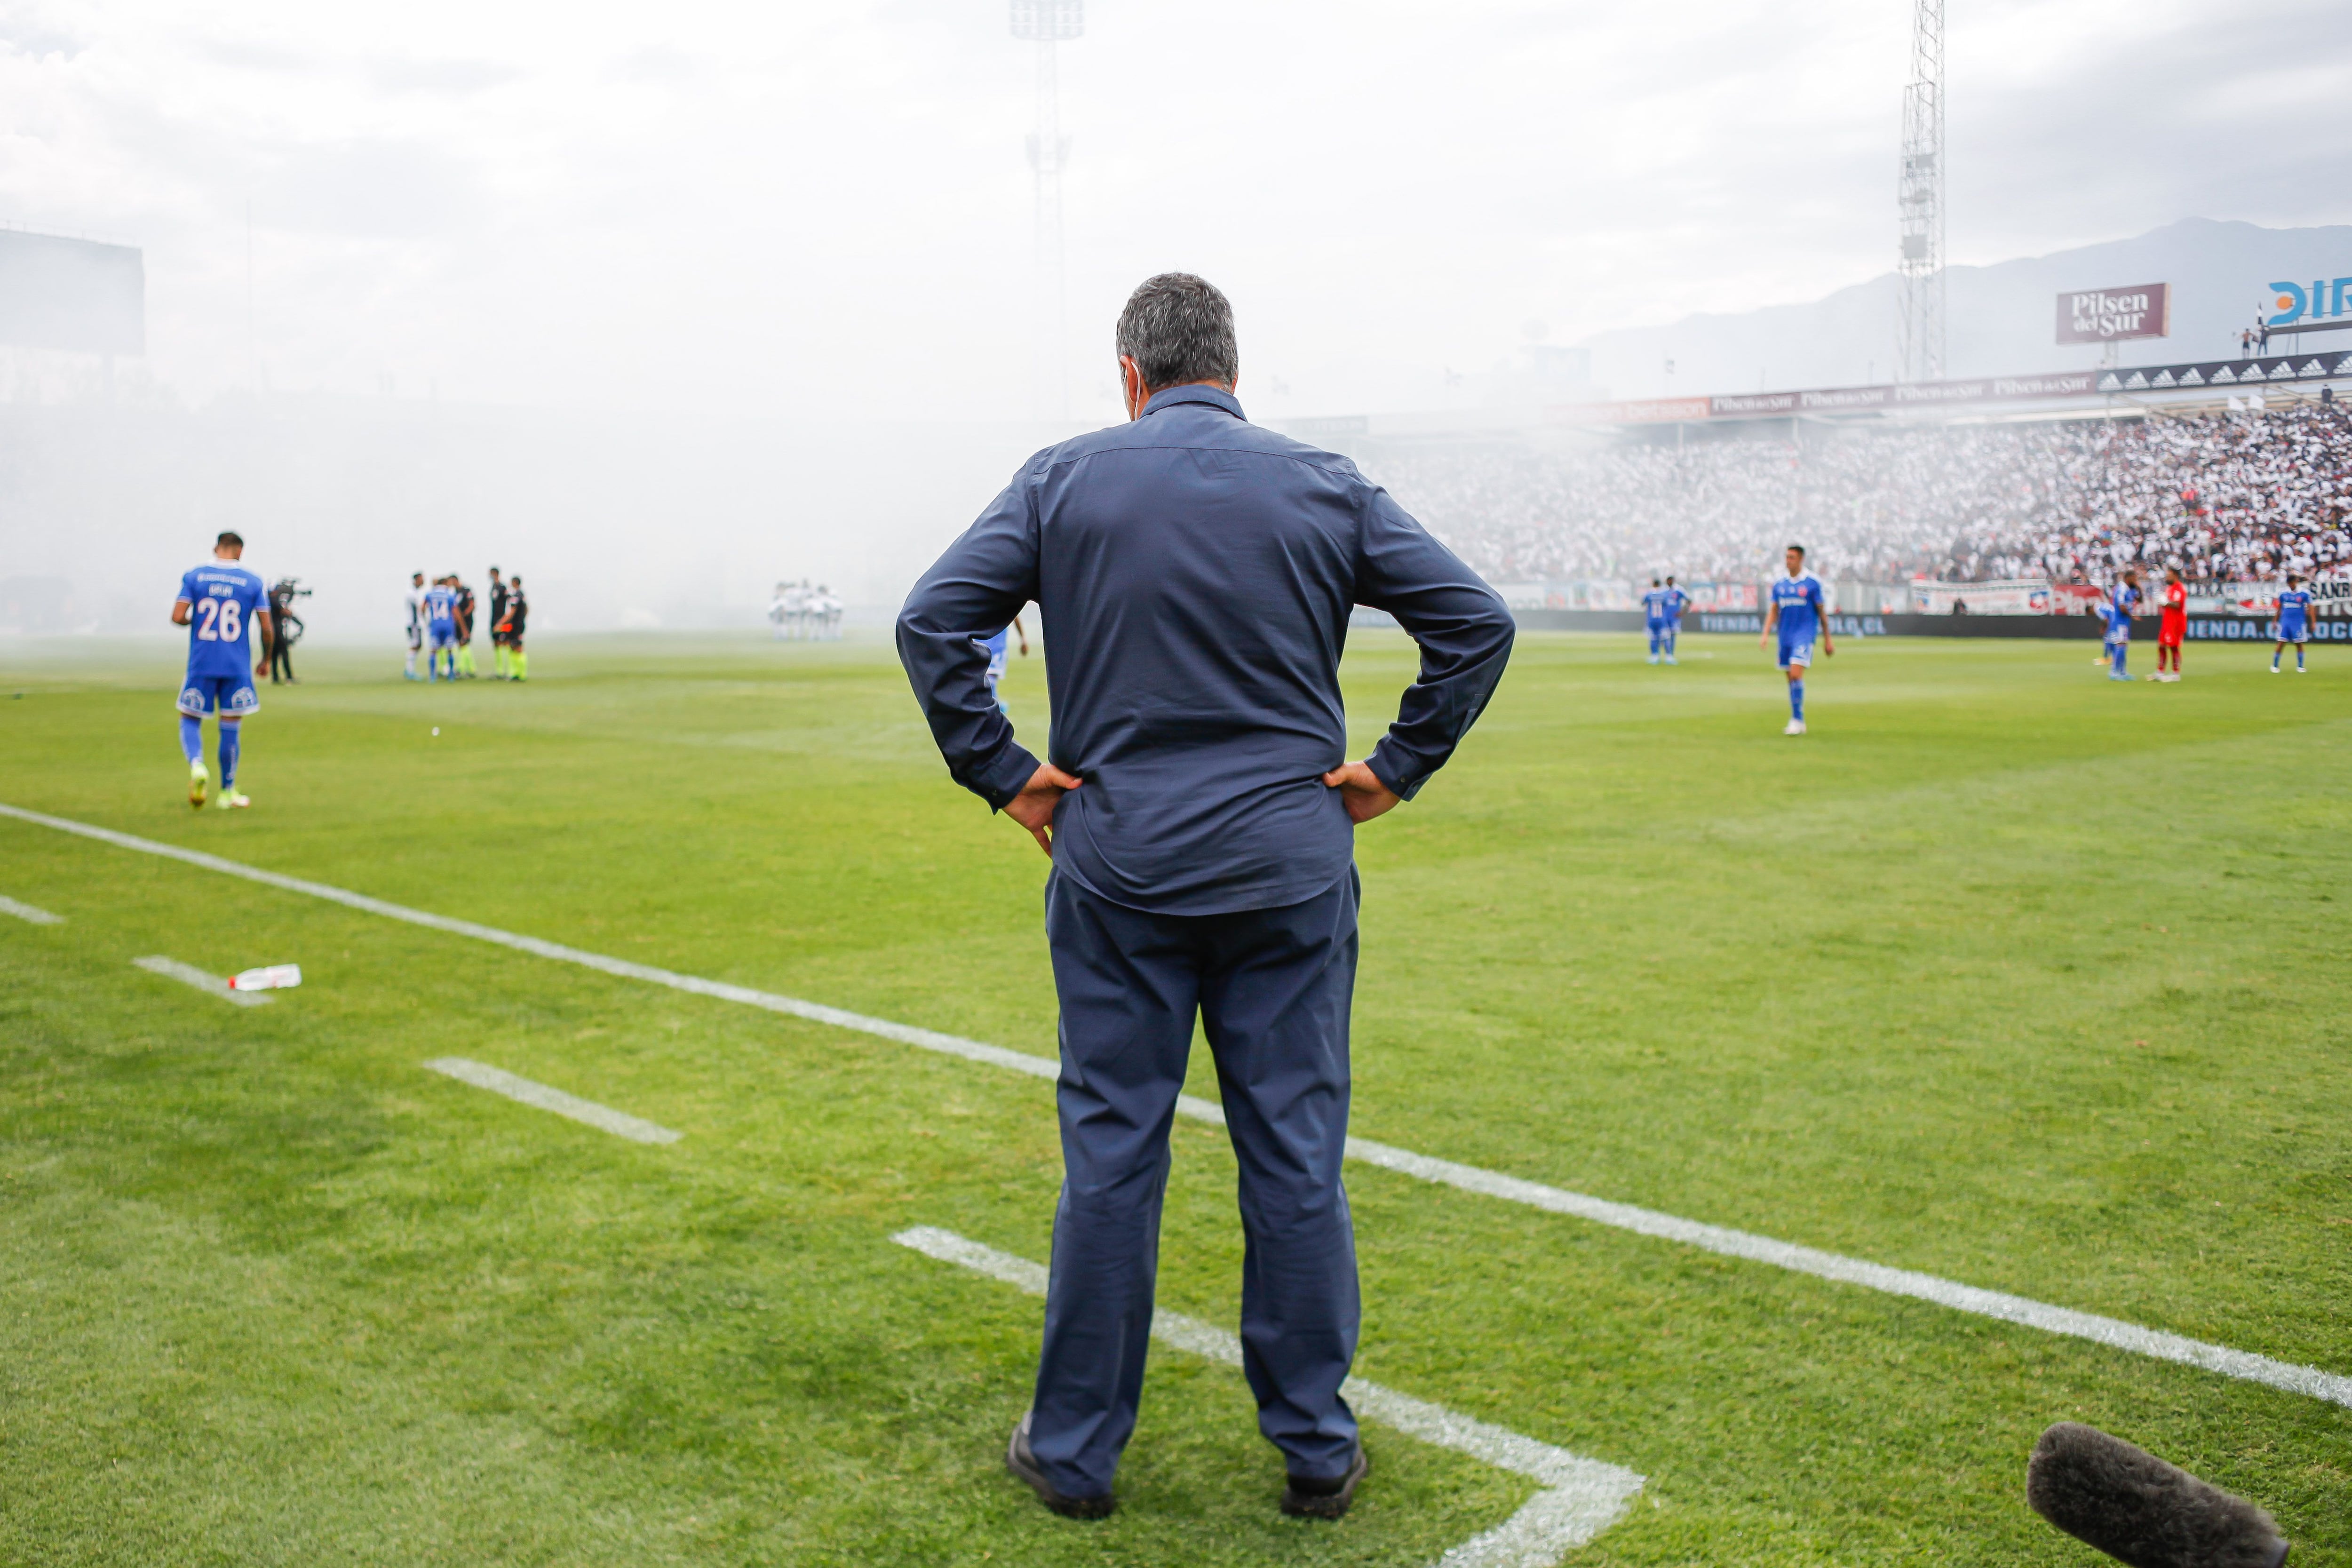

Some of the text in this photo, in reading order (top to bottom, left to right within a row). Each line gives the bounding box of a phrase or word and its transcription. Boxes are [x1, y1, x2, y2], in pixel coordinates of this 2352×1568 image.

[2072, 293, 2148, 316] Pilsen
[2073, 312, 2145, 337] del Sur
[198, 597, 241, 643] 26
